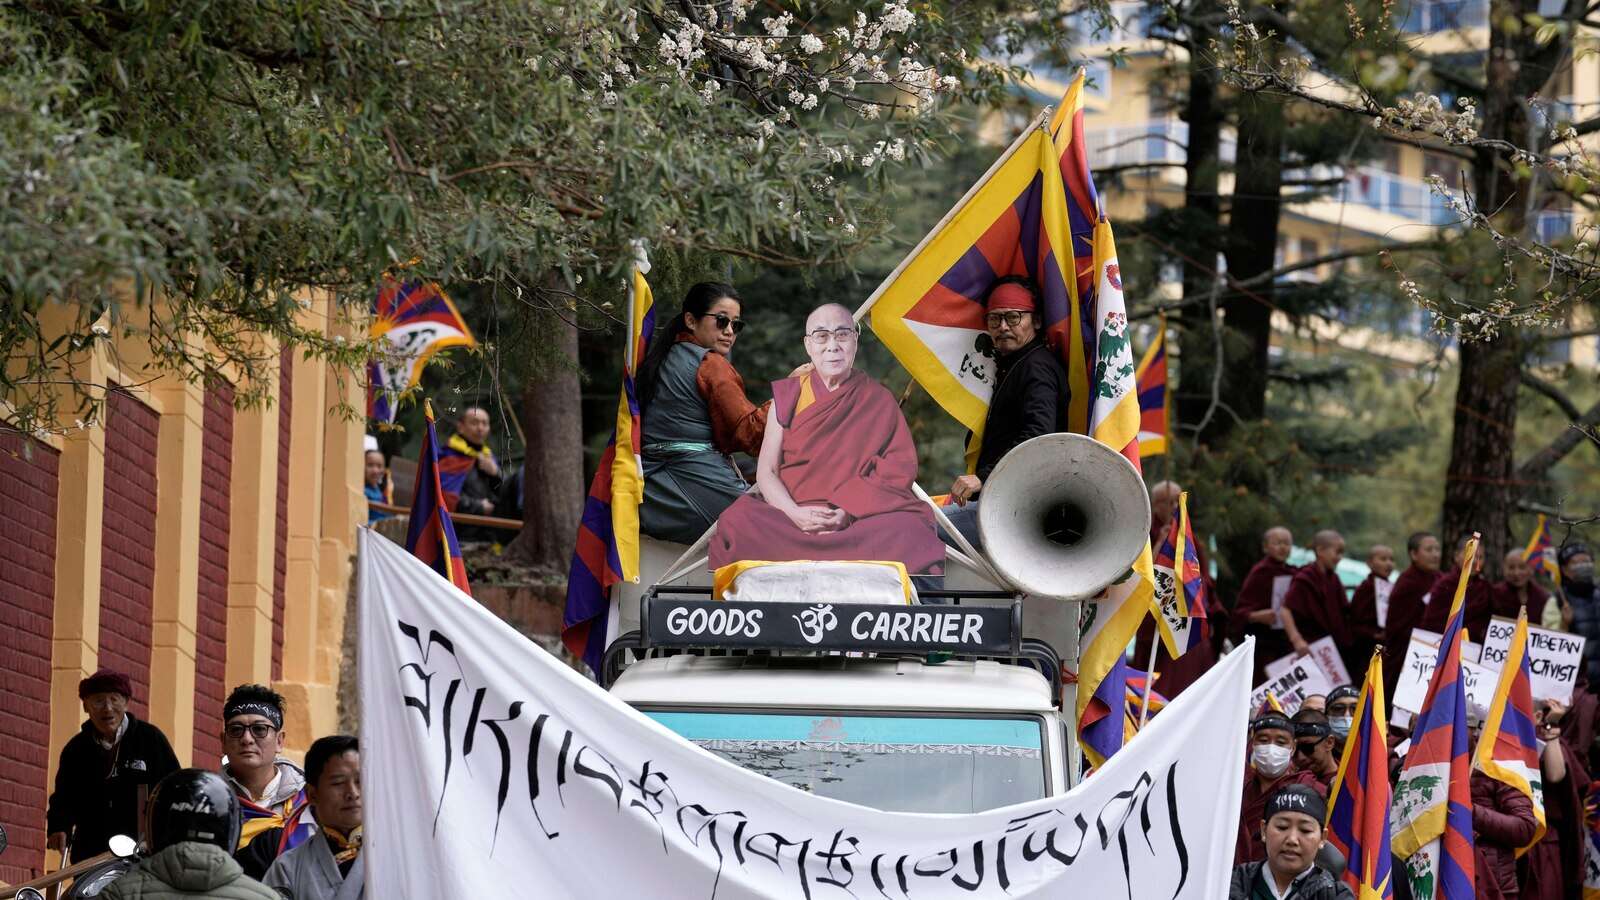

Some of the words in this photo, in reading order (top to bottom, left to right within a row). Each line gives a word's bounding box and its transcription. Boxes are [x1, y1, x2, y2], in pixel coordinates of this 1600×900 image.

[667, 606, 763, 637] GOODS
[851, 611, 983, 645] CARRIER
[1489, 625, 1515, 641] BOR
[1530, 632, 1581, 655] TIBETAN
[1529, 656, 1577, 682] CTIVIST
